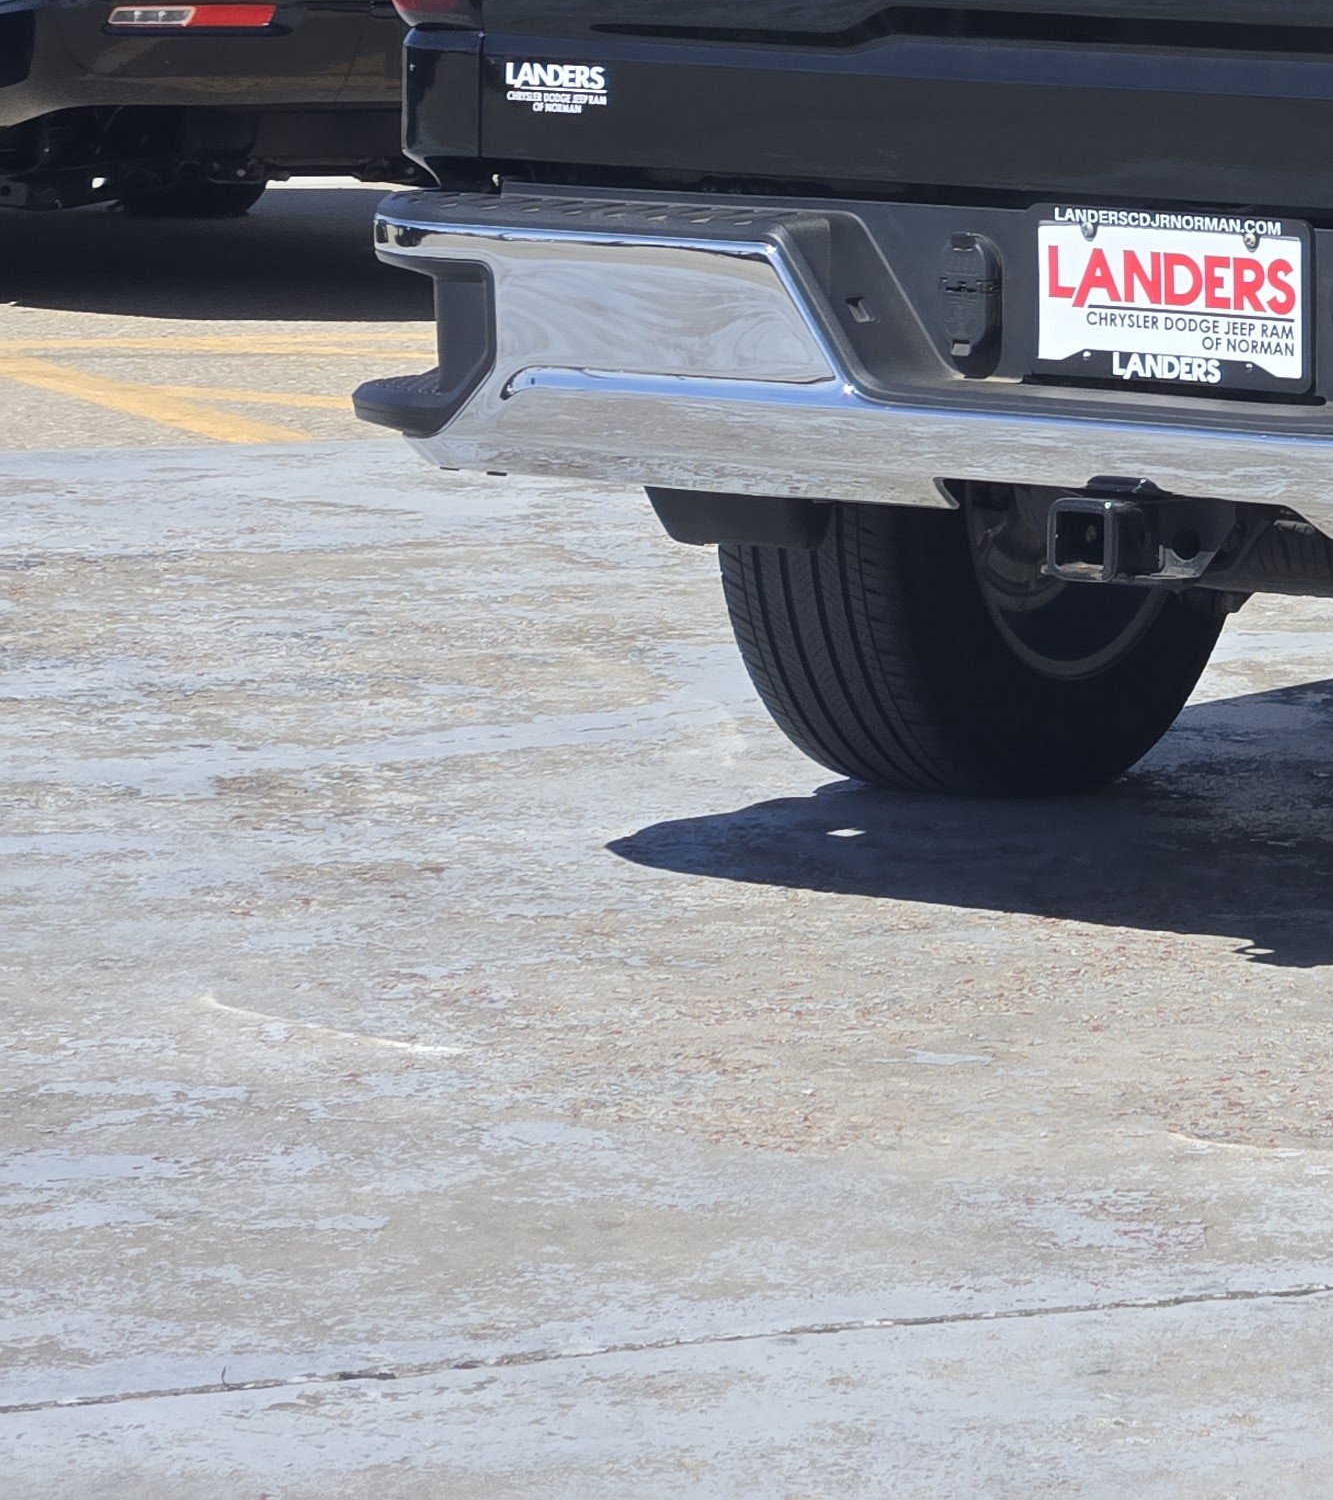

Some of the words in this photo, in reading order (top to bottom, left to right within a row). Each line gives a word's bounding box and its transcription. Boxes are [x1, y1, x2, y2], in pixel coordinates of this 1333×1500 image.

[505, 62, 605, 89] LANDERS
[532, 102, 544, 112] OF
[1054, 206, 1281, 236] LANDERSCDJRNORMAN.COM
[1048, 245, 1297, 316] LANDERS
[1086, 311, 1159, 330] CHRYSLER
[1164, 317, 1220, 335] DODGE
[1223, 321, 1256, 337] JEEP
[1260, 325, 1294, 341] RAM
[1202, 336, 1222, 351] OF
[1227, 338, 1294, 357] NORMAN
[1112, 351, 1221, 384] LANDERS
